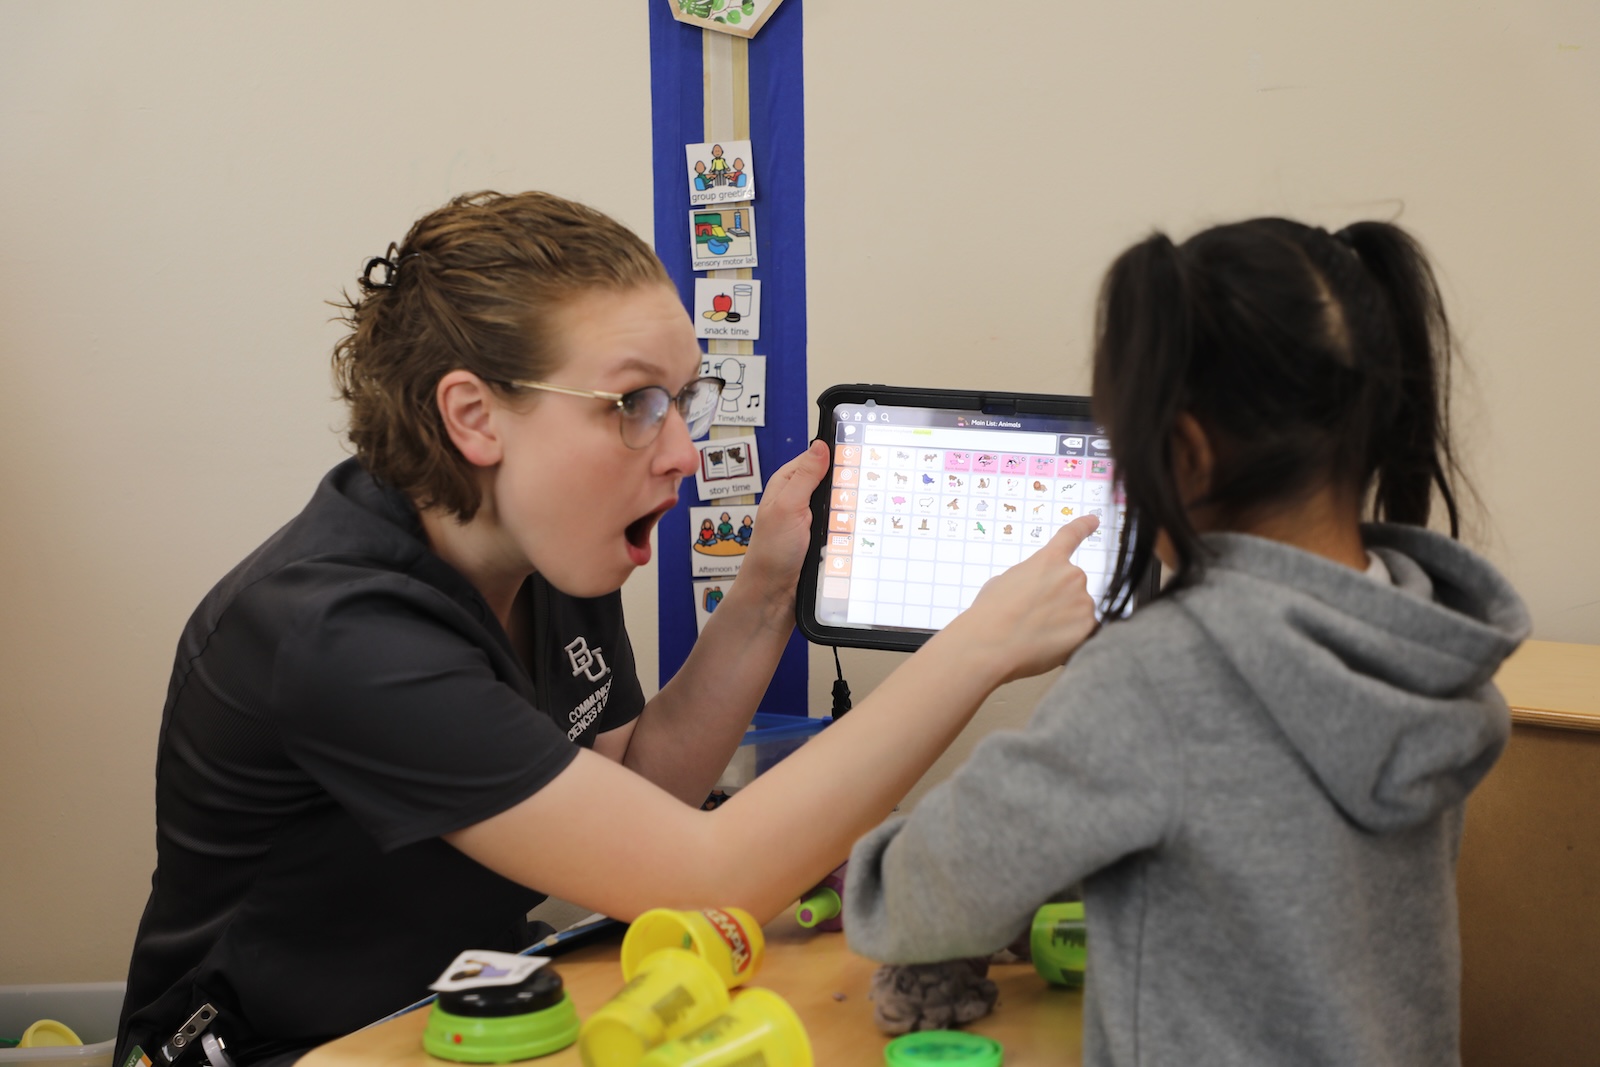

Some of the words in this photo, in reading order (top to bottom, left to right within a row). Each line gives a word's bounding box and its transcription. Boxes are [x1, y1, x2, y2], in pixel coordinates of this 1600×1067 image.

[692, 192, 717, 203] group
[693, 259, 721, 267] sensory
[722, 257, 744, 265] motor
[745, 256, 757, 264] lab
[704, 326, 728, 335] snack
[730, 327, 749, 336] time
[717, 414, 758, 423] Time/Music
[709, 485, 730, 495] story
[731, 483, 751, 492] time
[564, 636, 607, 682] BU
